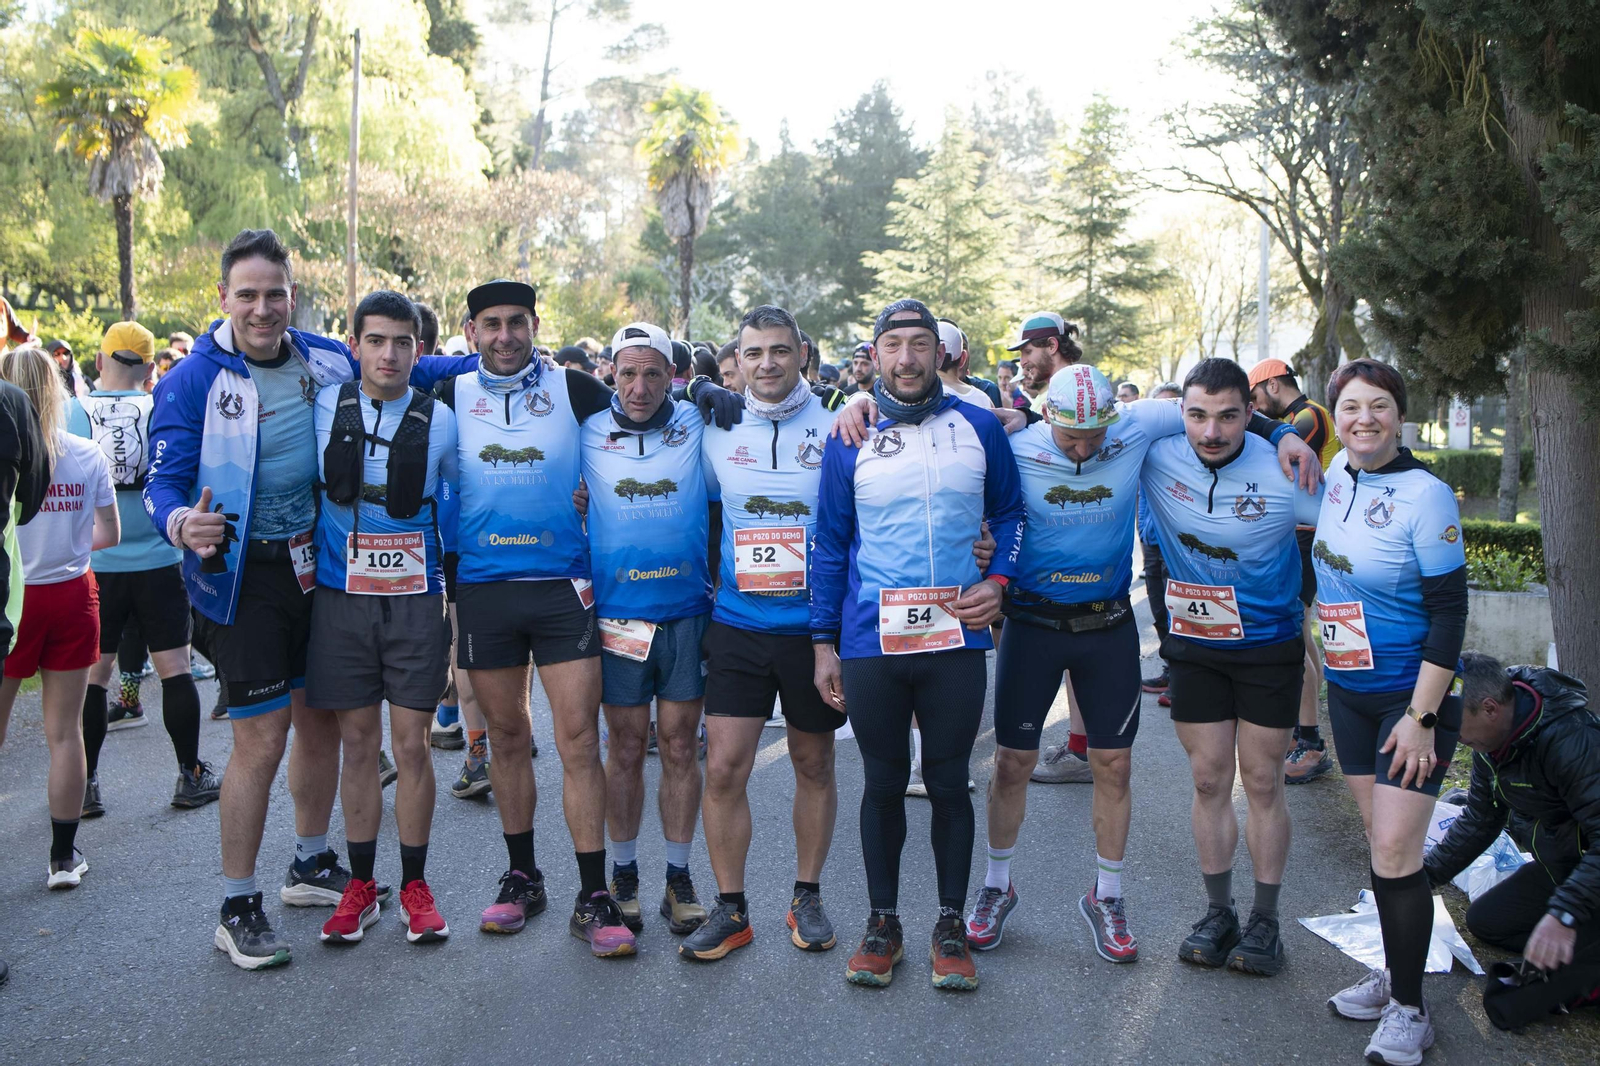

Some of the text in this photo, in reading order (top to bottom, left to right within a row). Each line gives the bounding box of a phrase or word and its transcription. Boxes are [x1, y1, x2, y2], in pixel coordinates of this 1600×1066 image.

[1077, 388, 1086, 424] INDARRA
[353, 537, 371, 546] RAIL
[489, 533, 539, 546] Demillo
[737, 532, 801, 542] TRAIL POZO DO DEMO
[368, 552, 404, 568] 102
[753, 547, 776, 563] 52
[628, 566, 680, 581] Demillo
[1050, 571, 1101, 584] Demillo
[885, 594, 904, 602] TRAIL
[907, 592, 928, 601] POZO
[928, 592, 938, 600] DO
[1185, 588, 1200, 596] POZO
[1202, 589, 1211, 597] DO
[907, 607, 932, 625] 54
[1187, 601, 1210, 617] 41
[1329, 609, 1338, 618] DO
[1338, 607, 1358, 617] DEMO
[1323, 624, 1337, 641] 47
